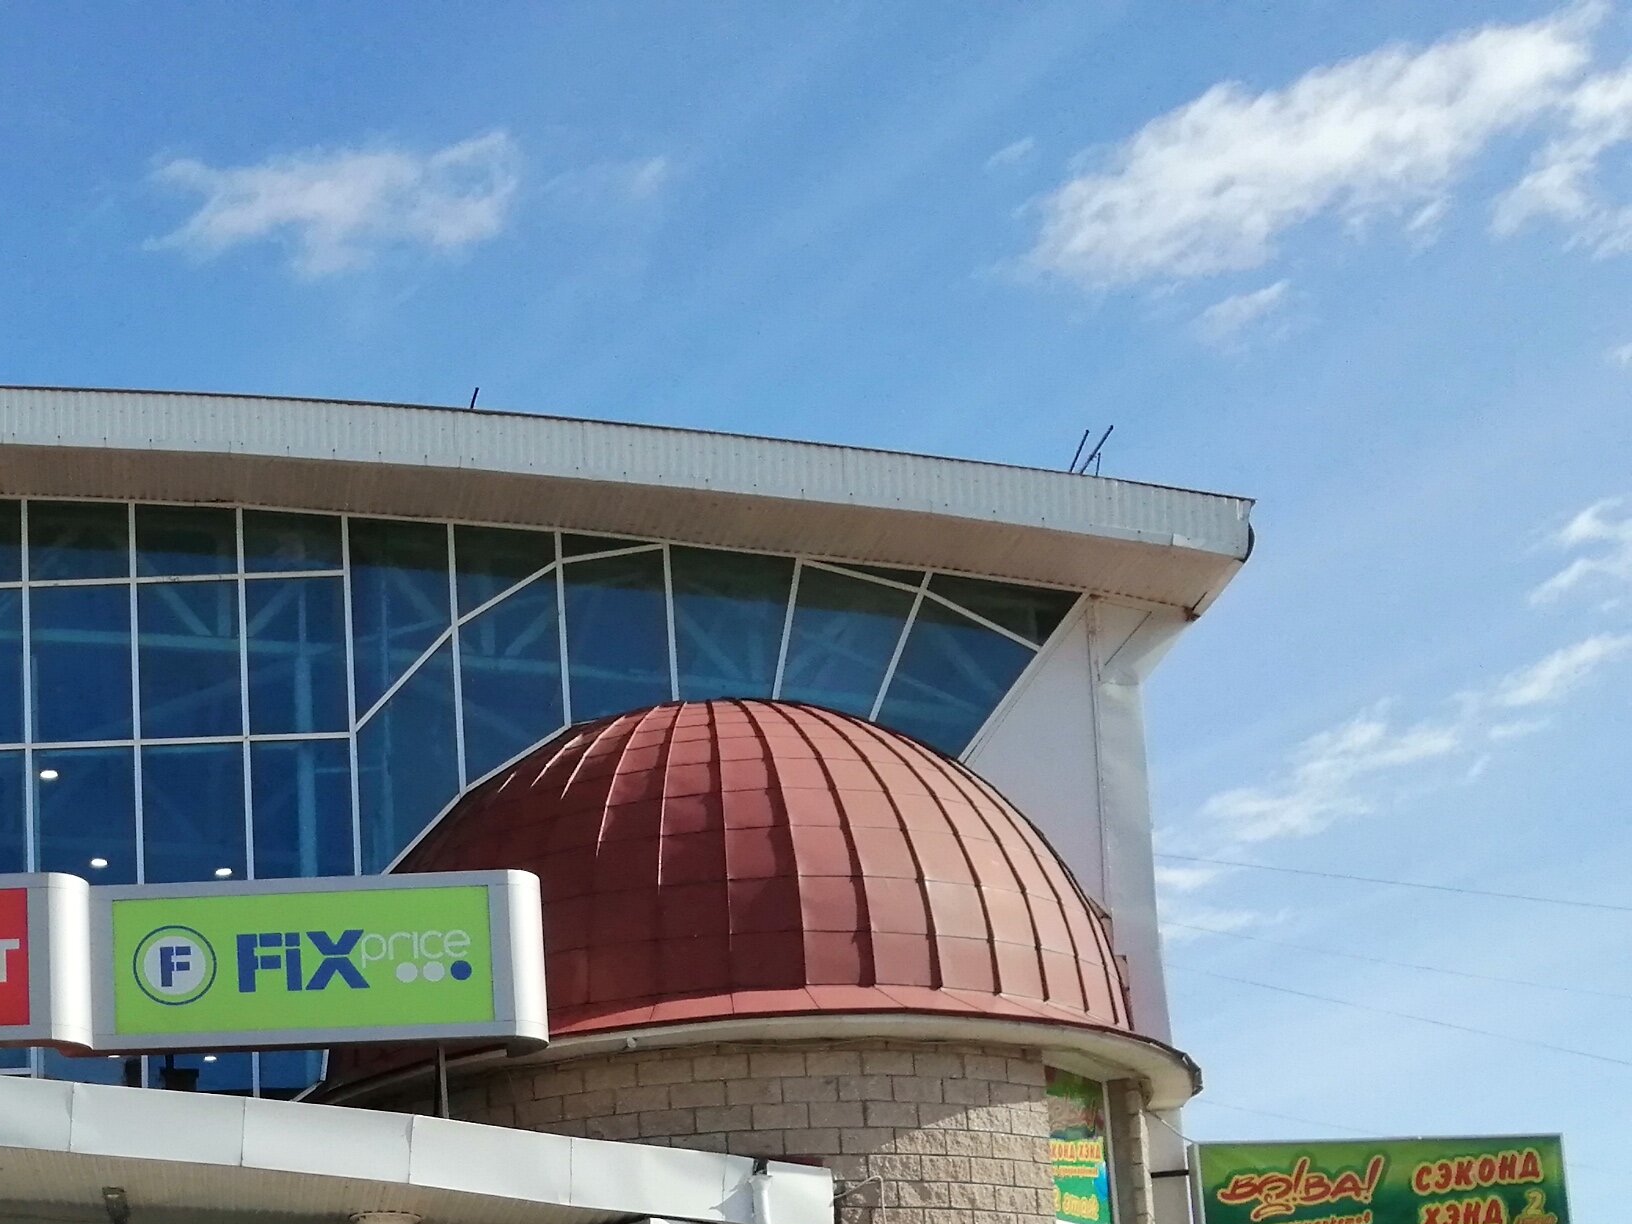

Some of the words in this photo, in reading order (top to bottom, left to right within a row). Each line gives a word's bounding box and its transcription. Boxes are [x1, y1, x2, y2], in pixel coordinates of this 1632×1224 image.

[360, 929, 472, 969] price
[1413, 1149, 1546, 1196] СЭКОНД
[1521, 1189, 1546, 1216] 2
